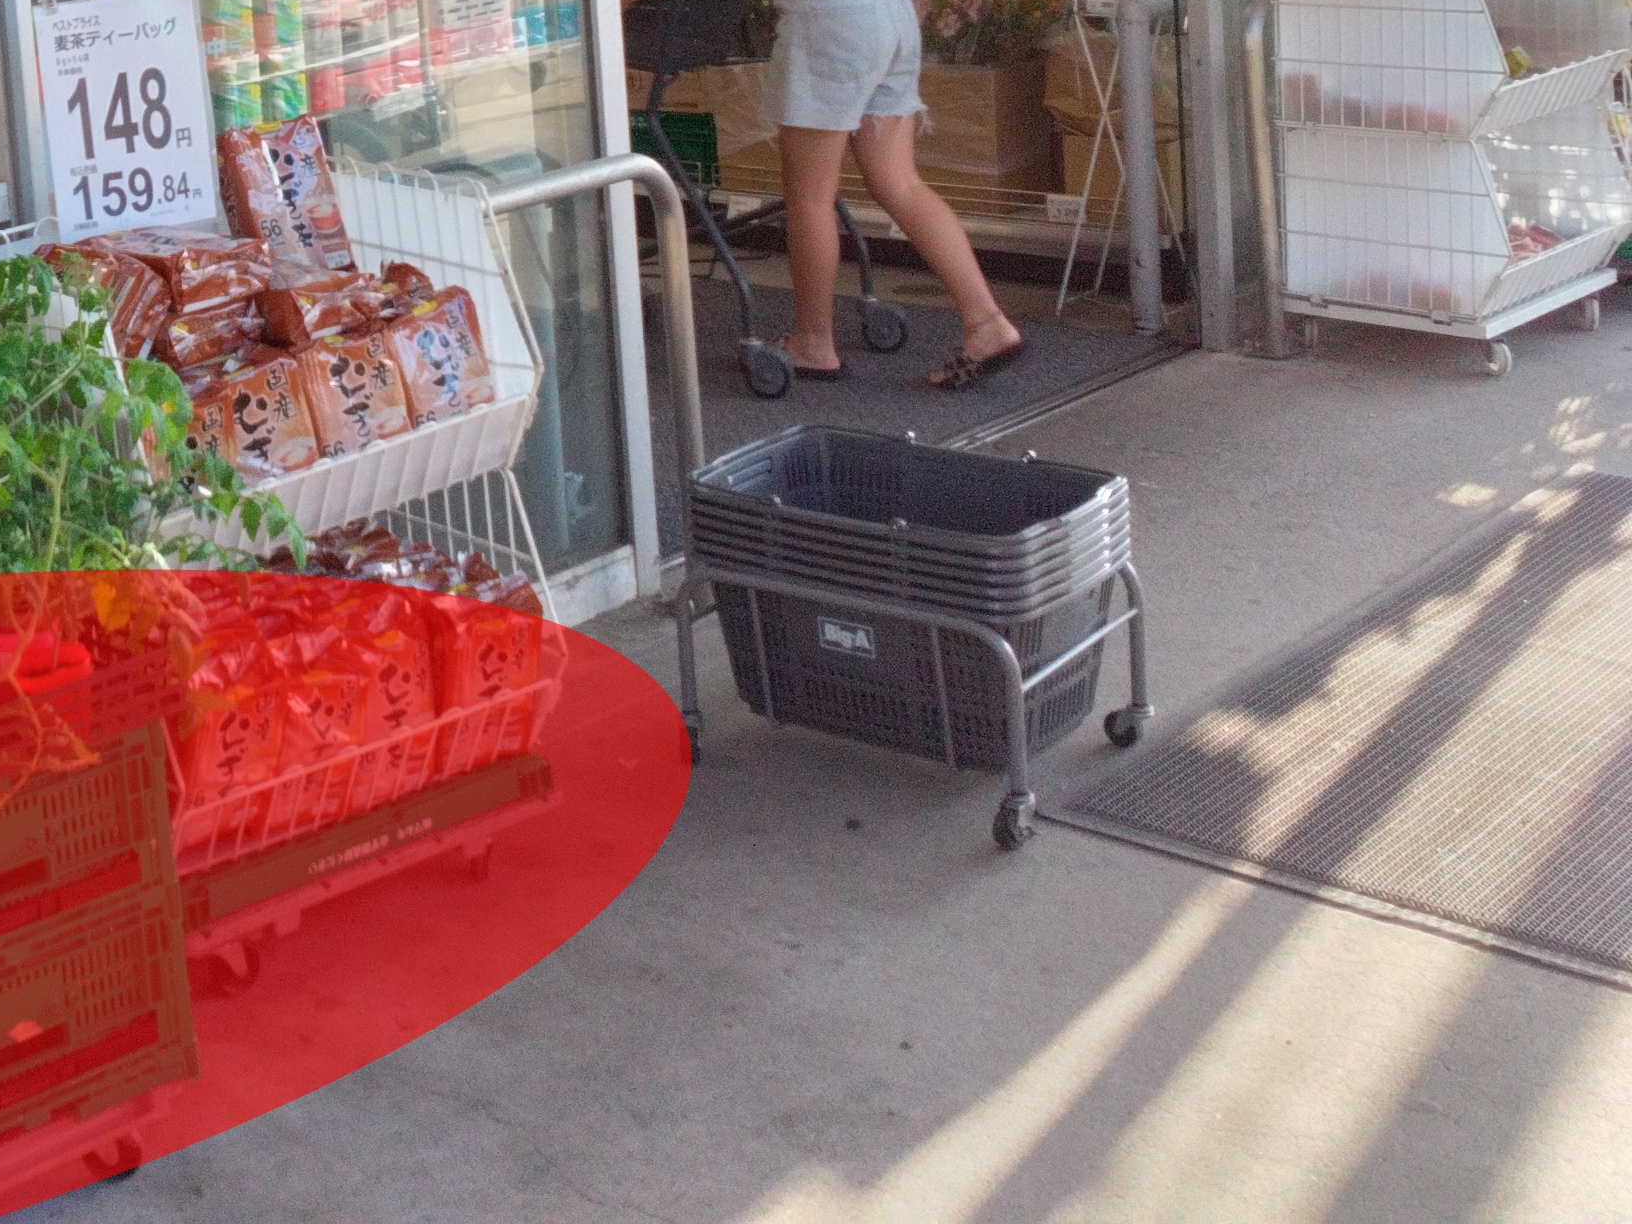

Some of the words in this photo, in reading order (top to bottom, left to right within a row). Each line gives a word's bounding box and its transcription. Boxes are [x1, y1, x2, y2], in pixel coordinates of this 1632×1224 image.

[52, 15, 101, 31] ベストプライス
[54, 16, 178, 53] 麦茶ティーバッグ
[67, 66, 173, 161] 148
[175, 127, 194, 149] 円
[73, 167, 191, 221] 159.84
[261, 218, 283, 239] 56
[367, 333, 392, 391] 国産
[266, 362, 295, 424] 国産
